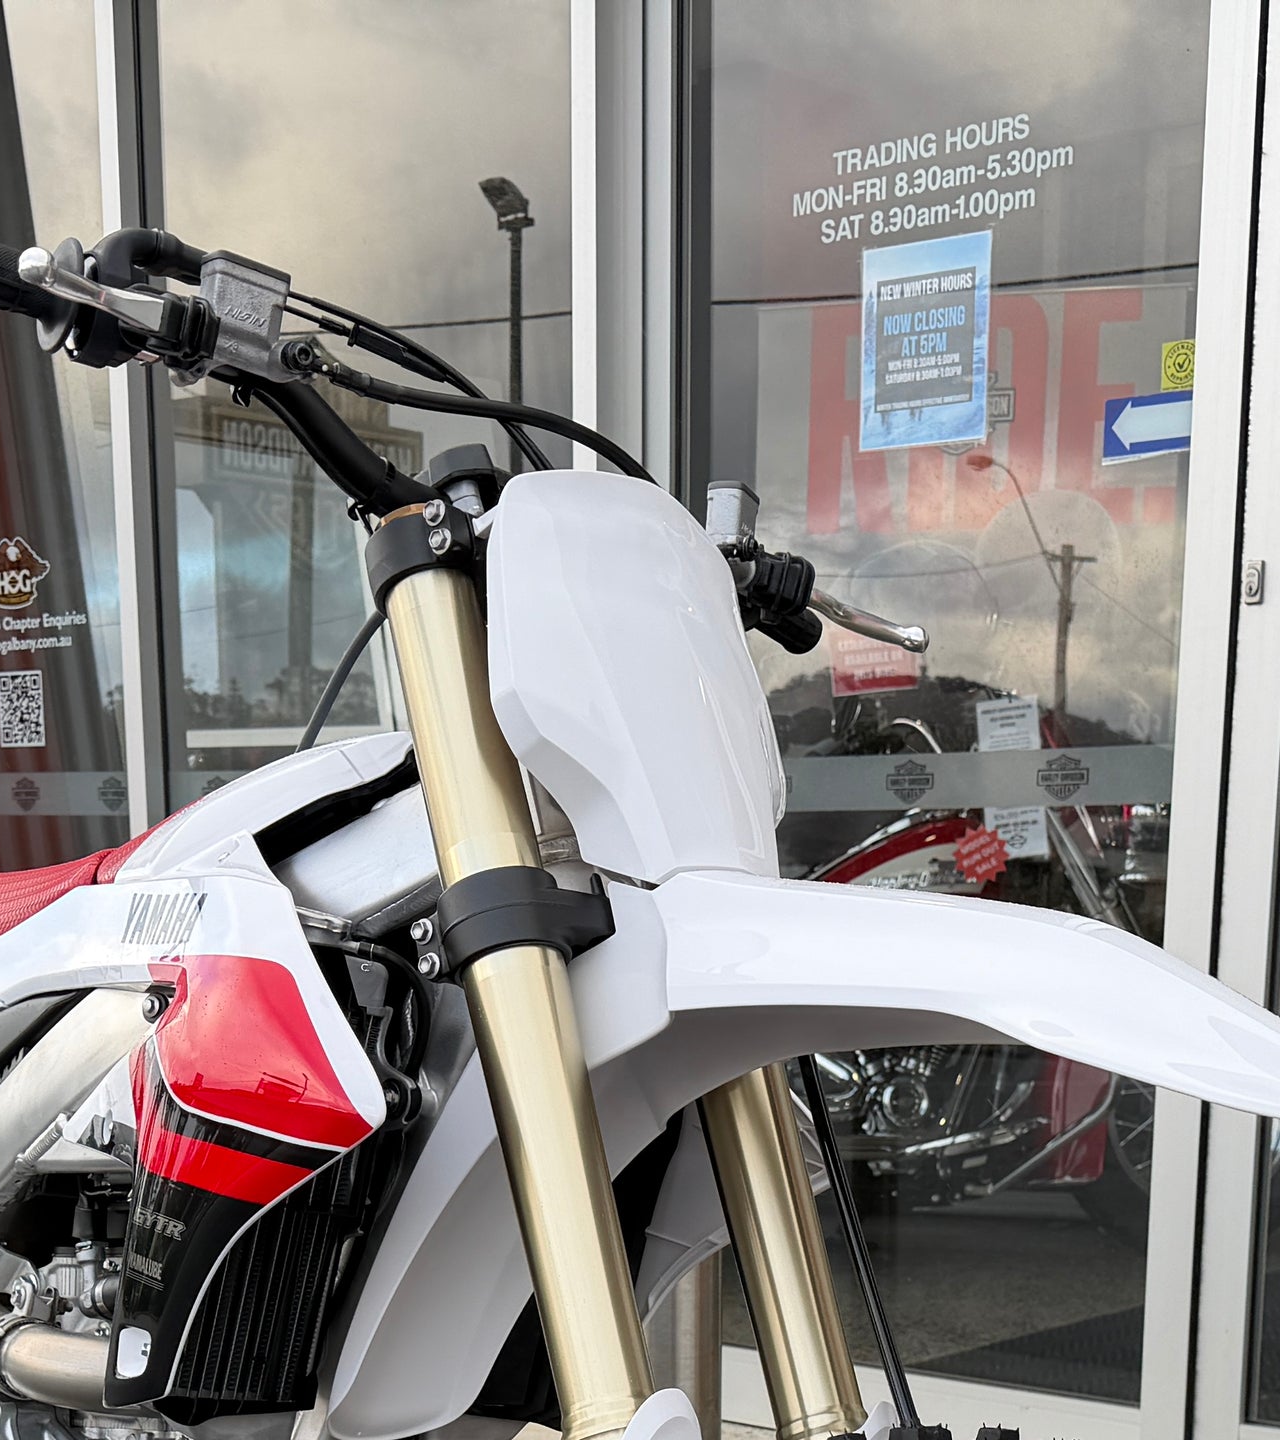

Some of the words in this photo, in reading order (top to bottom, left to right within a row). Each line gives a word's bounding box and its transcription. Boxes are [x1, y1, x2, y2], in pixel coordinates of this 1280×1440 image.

[832, 133, 937, 176] TRADING
[945, 113, 1030, 154] HOURS
[792, 175, 887, 217] MON-FRI
[894, 145, 1074, 198] 8.30am-5.30pm
[820, 214, 865, 244] SAT
[870, 187, 1036, 236] 8.30am-1.00pm
[880, 284, 902, 302] NEW
[903, 278, 938, 299] WINTER
[941, 272, 973, 293] HOURS
[883, 313, 912, 337] NOW
[914, 305, 965, 332] CLOSING
[901, 336, 918, 357] AT
[920, 332, 948, 355] 5PM
[2, 616, 41, 634] Chapter
[42, 611, 87, 632] Enquiries
[121, 893, 208, 945] YAMAHA
[132, 1206, 187, 1241] GYTR
[127, 1251, 163, 1281] YAMALUBE
